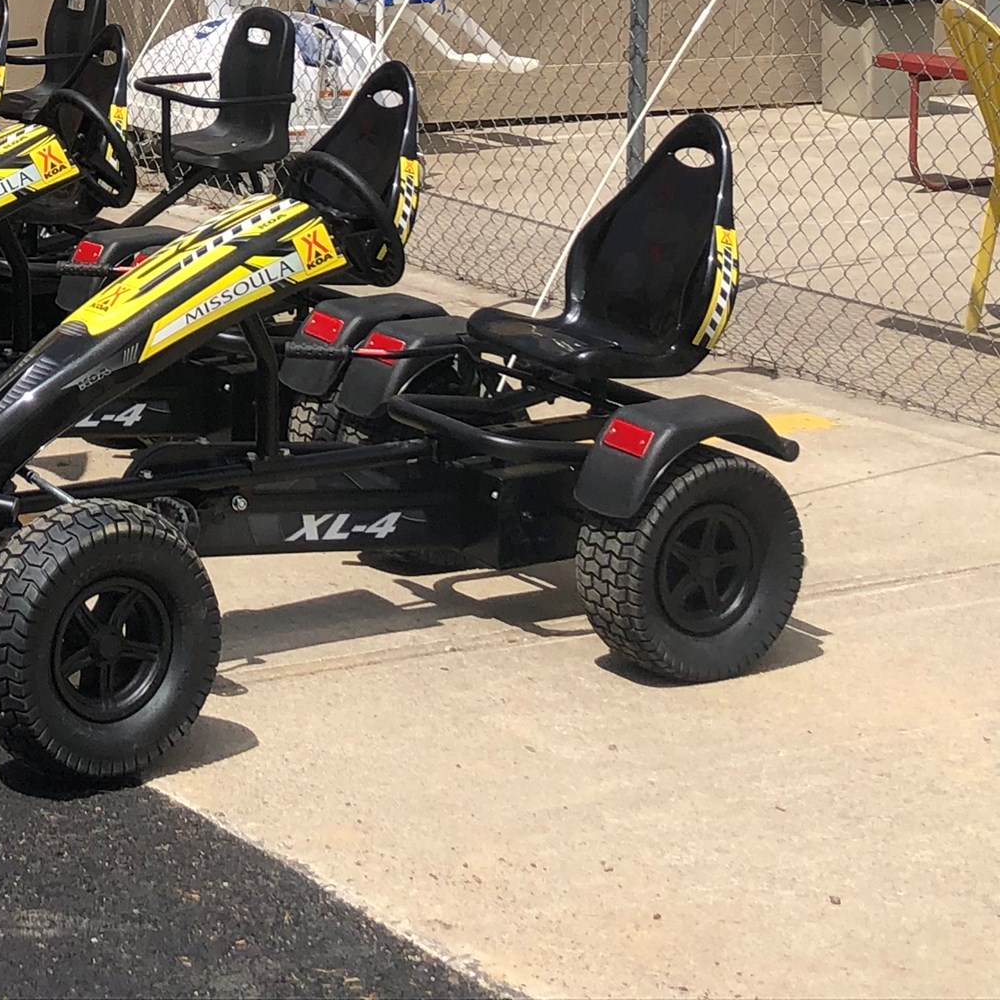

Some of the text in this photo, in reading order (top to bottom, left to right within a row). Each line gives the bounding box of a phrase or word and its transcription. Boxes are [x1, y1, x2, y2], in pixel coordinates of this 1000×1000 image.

[44, 163, 67, 180] KOA
[306, 252, 334, 271] KOA
[184, 260, 295, 324] MISSOULA
[285, 512, 402, 542] XL-4
